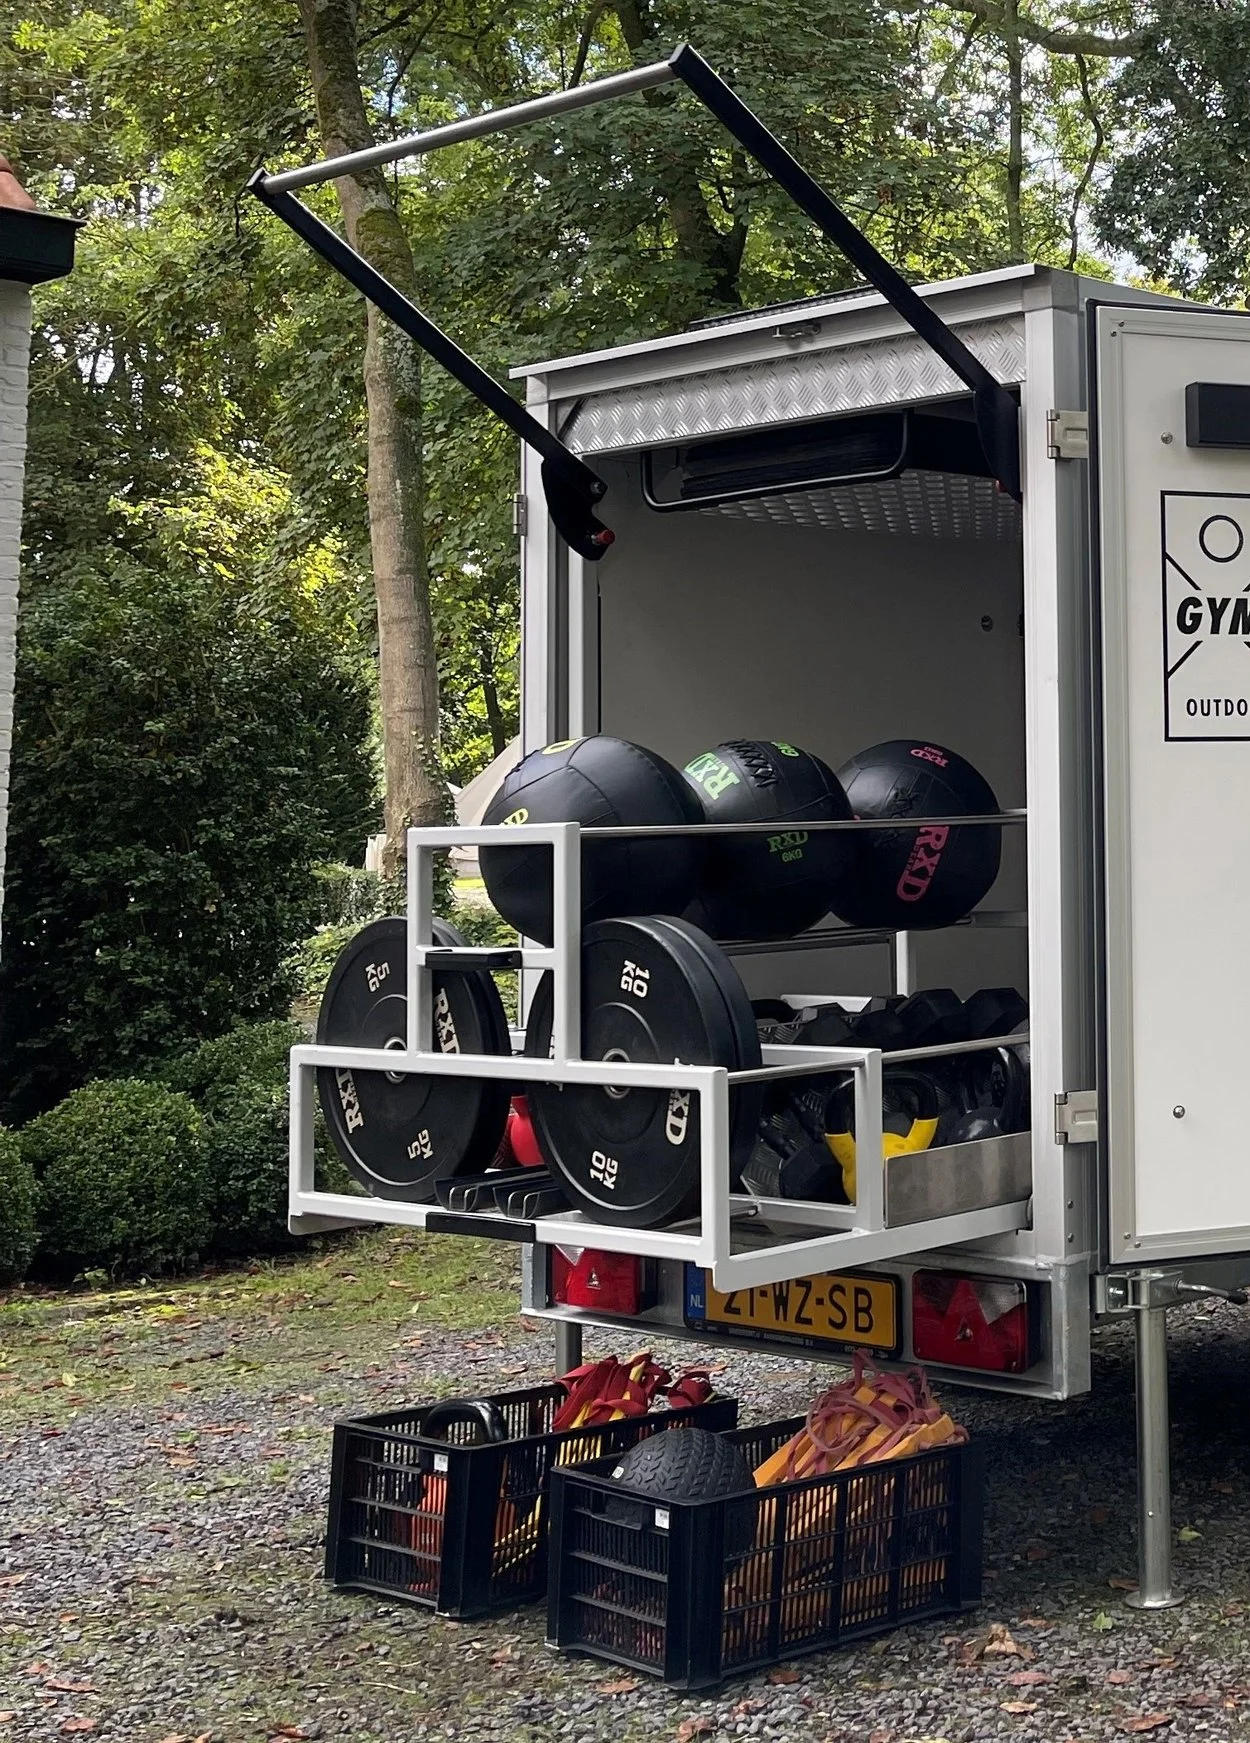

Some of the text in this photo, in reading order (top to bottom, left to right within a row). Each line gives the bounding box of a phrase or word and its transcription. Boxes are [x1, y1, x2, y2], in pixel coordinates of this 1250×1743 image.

[684, 752, 740, 800] RXD
[767, 831, 808, 852] RXD
[897, 826, 949, 901] RXD
[365, 963, 380, 993] KG
[376, 962, 391, 981] 5
[620, 960, 636, 993] KG
[632, 966, 650, 998] 10
[408, 1142, 422, 1160] 5
[417, 1128, 434, 1159] KG
[590, 1150, 606, 1182] 10
[602, 1157, 618, 1190] KG
[690, 1295, 703, 1308] NL
